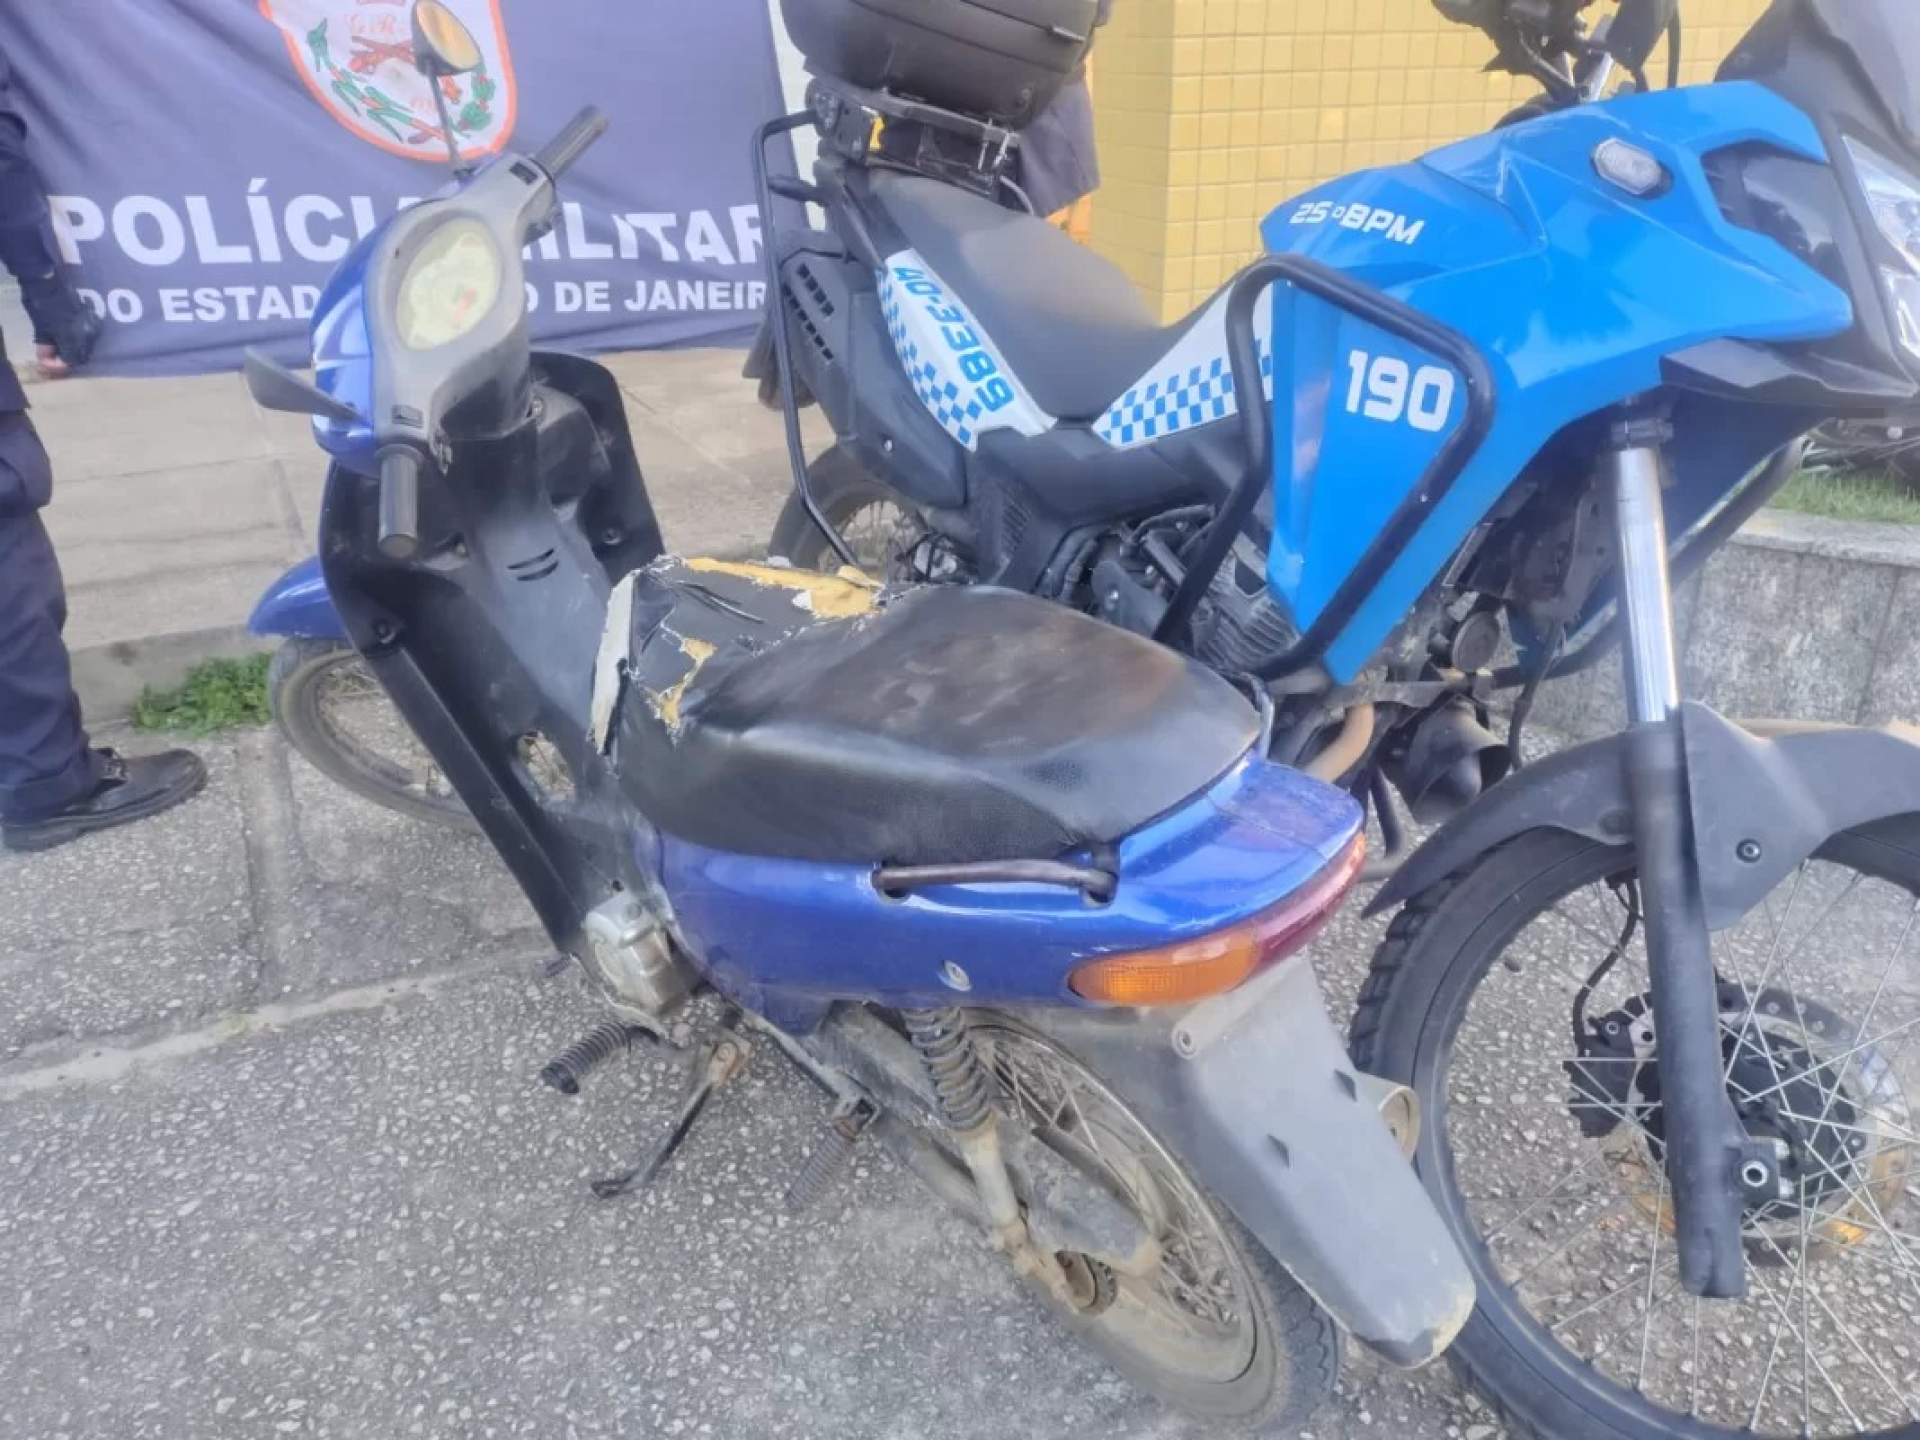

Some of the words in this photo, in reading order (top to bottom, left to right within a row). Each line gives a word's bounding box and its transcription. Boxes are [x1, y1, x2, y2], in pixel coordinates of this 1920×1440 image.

[48, 177, 421, 266] POLÍCI
[523, 202, 763, 265] LITAR
[158, 285, 321, 323] ESTAD
[554, 281, 611, 313] DE
[624, 280, 766, 311] JANEIR
[1345, 350, 1454, 432] 190
